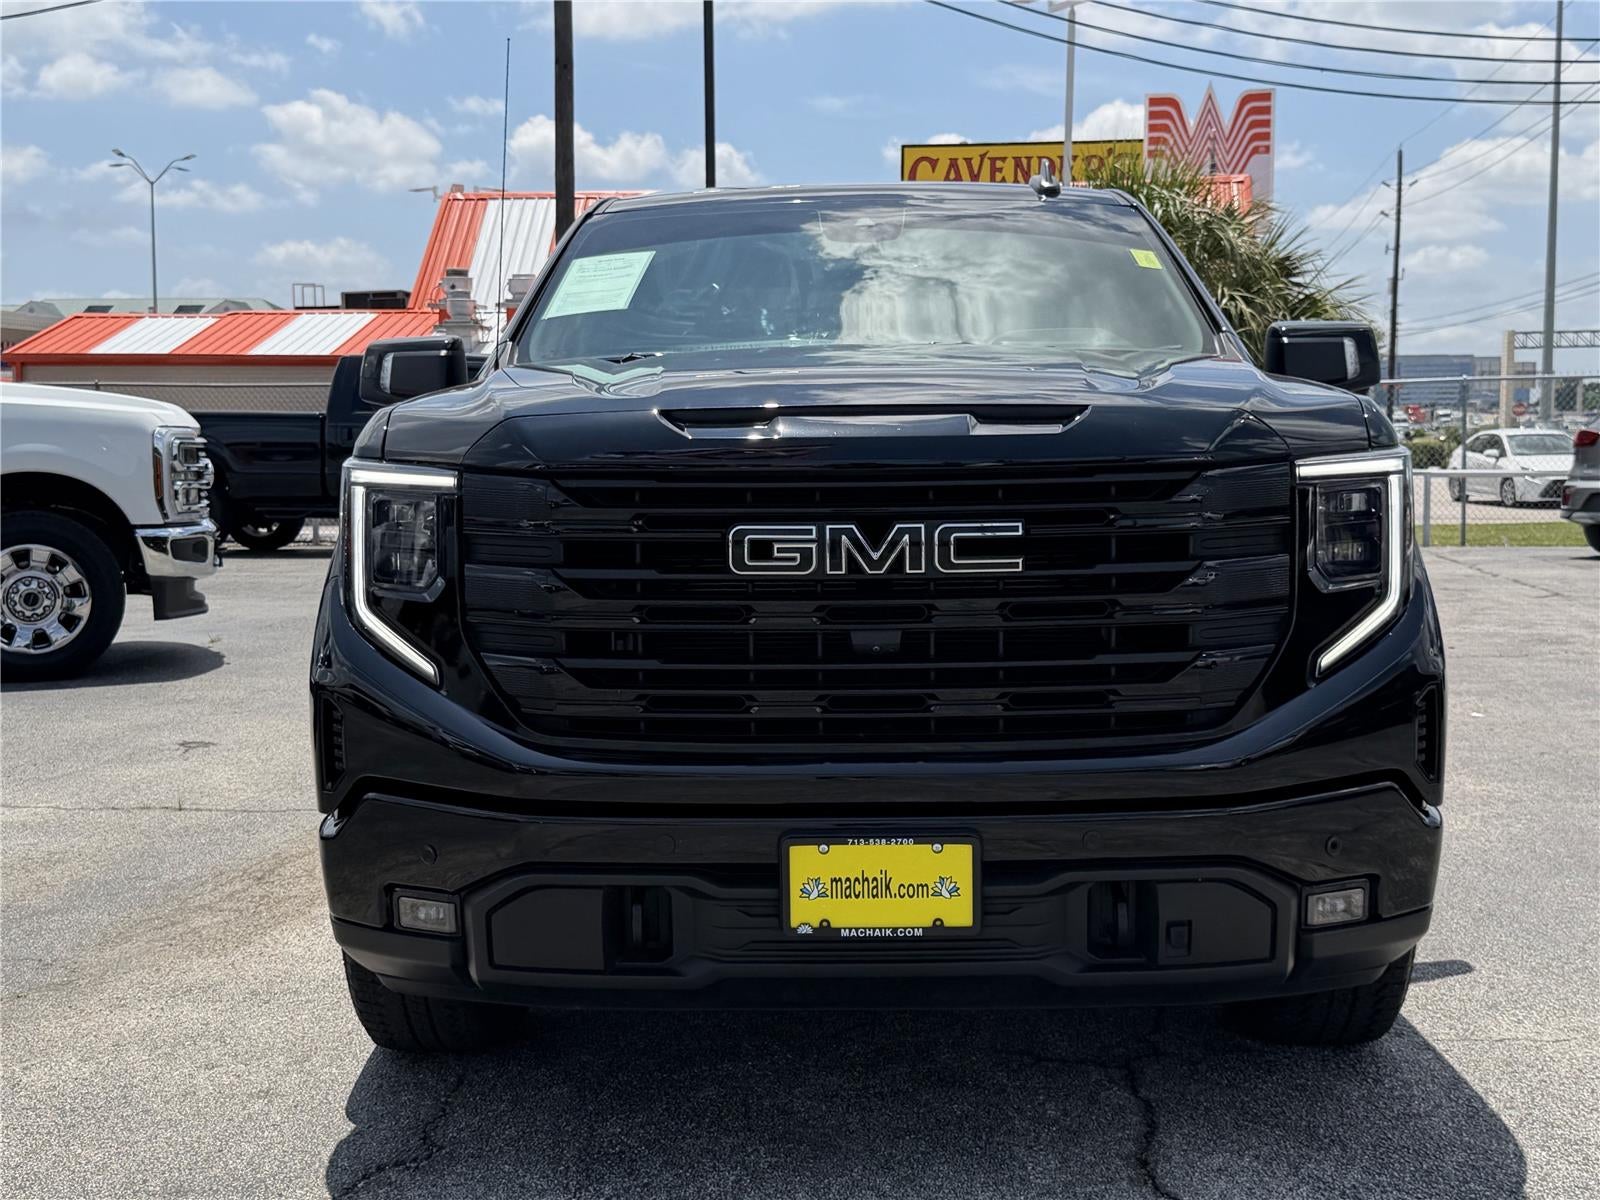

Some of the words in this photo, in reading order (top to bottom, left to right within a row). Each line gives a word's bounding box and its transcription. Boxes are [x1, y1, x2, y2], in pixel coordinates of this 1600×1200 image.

[729, 523, 1023, 575] GMC
[847, 838, 914, 846] 713-538-2700
[830, 869, 930, 899] machaik.com
[840, 927, 924, 937] MACHAIK.COM
